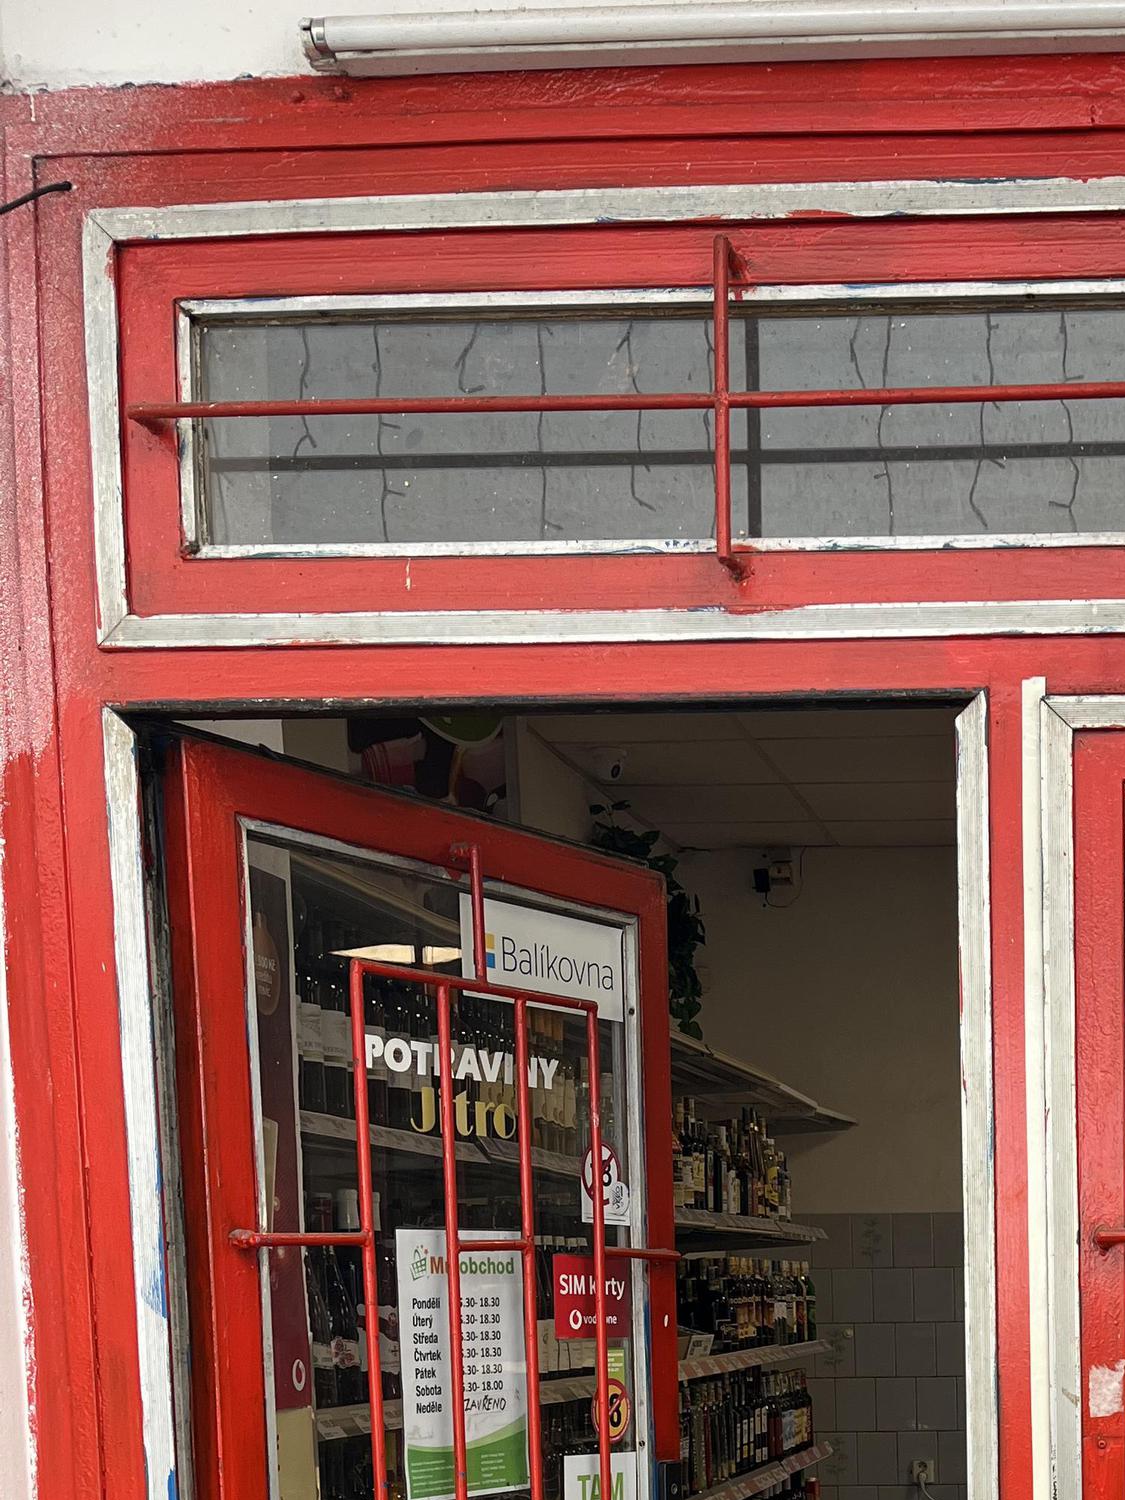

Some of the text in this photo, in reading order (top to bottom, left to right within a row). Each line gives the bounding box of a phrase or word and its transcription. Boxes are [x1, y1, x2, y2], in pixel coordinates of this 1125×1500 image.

[501, 935, 614, 991] Balíkovna
[459, 1256, 515, 1275] obchod
[559, 1273, 625, 1301] SIM krty
[480, 1297, 500, 1308] 18.30
[412, 1313, 434, 1329] Úterý
[480, 1314, 500, 1324] 18.30
[413, 1332, 439, 1345] Středa
[480, 1330, 501, 1341] 18.30
[414, 1348, 442, 1362] Čtvrtek
[481, 1347, 502, 1358] 18.30
[415, 1367, 437, 1380] Pátek
[481, 1364, 503, 1375] 18.30
[416, 1384, 442, 1397] Sobota
[482, 1380, 504, 1391] 18.00
[416, 1402, 442, 1415] Neděle
[464, 1394, 507, 1412] ZAVŘENO
